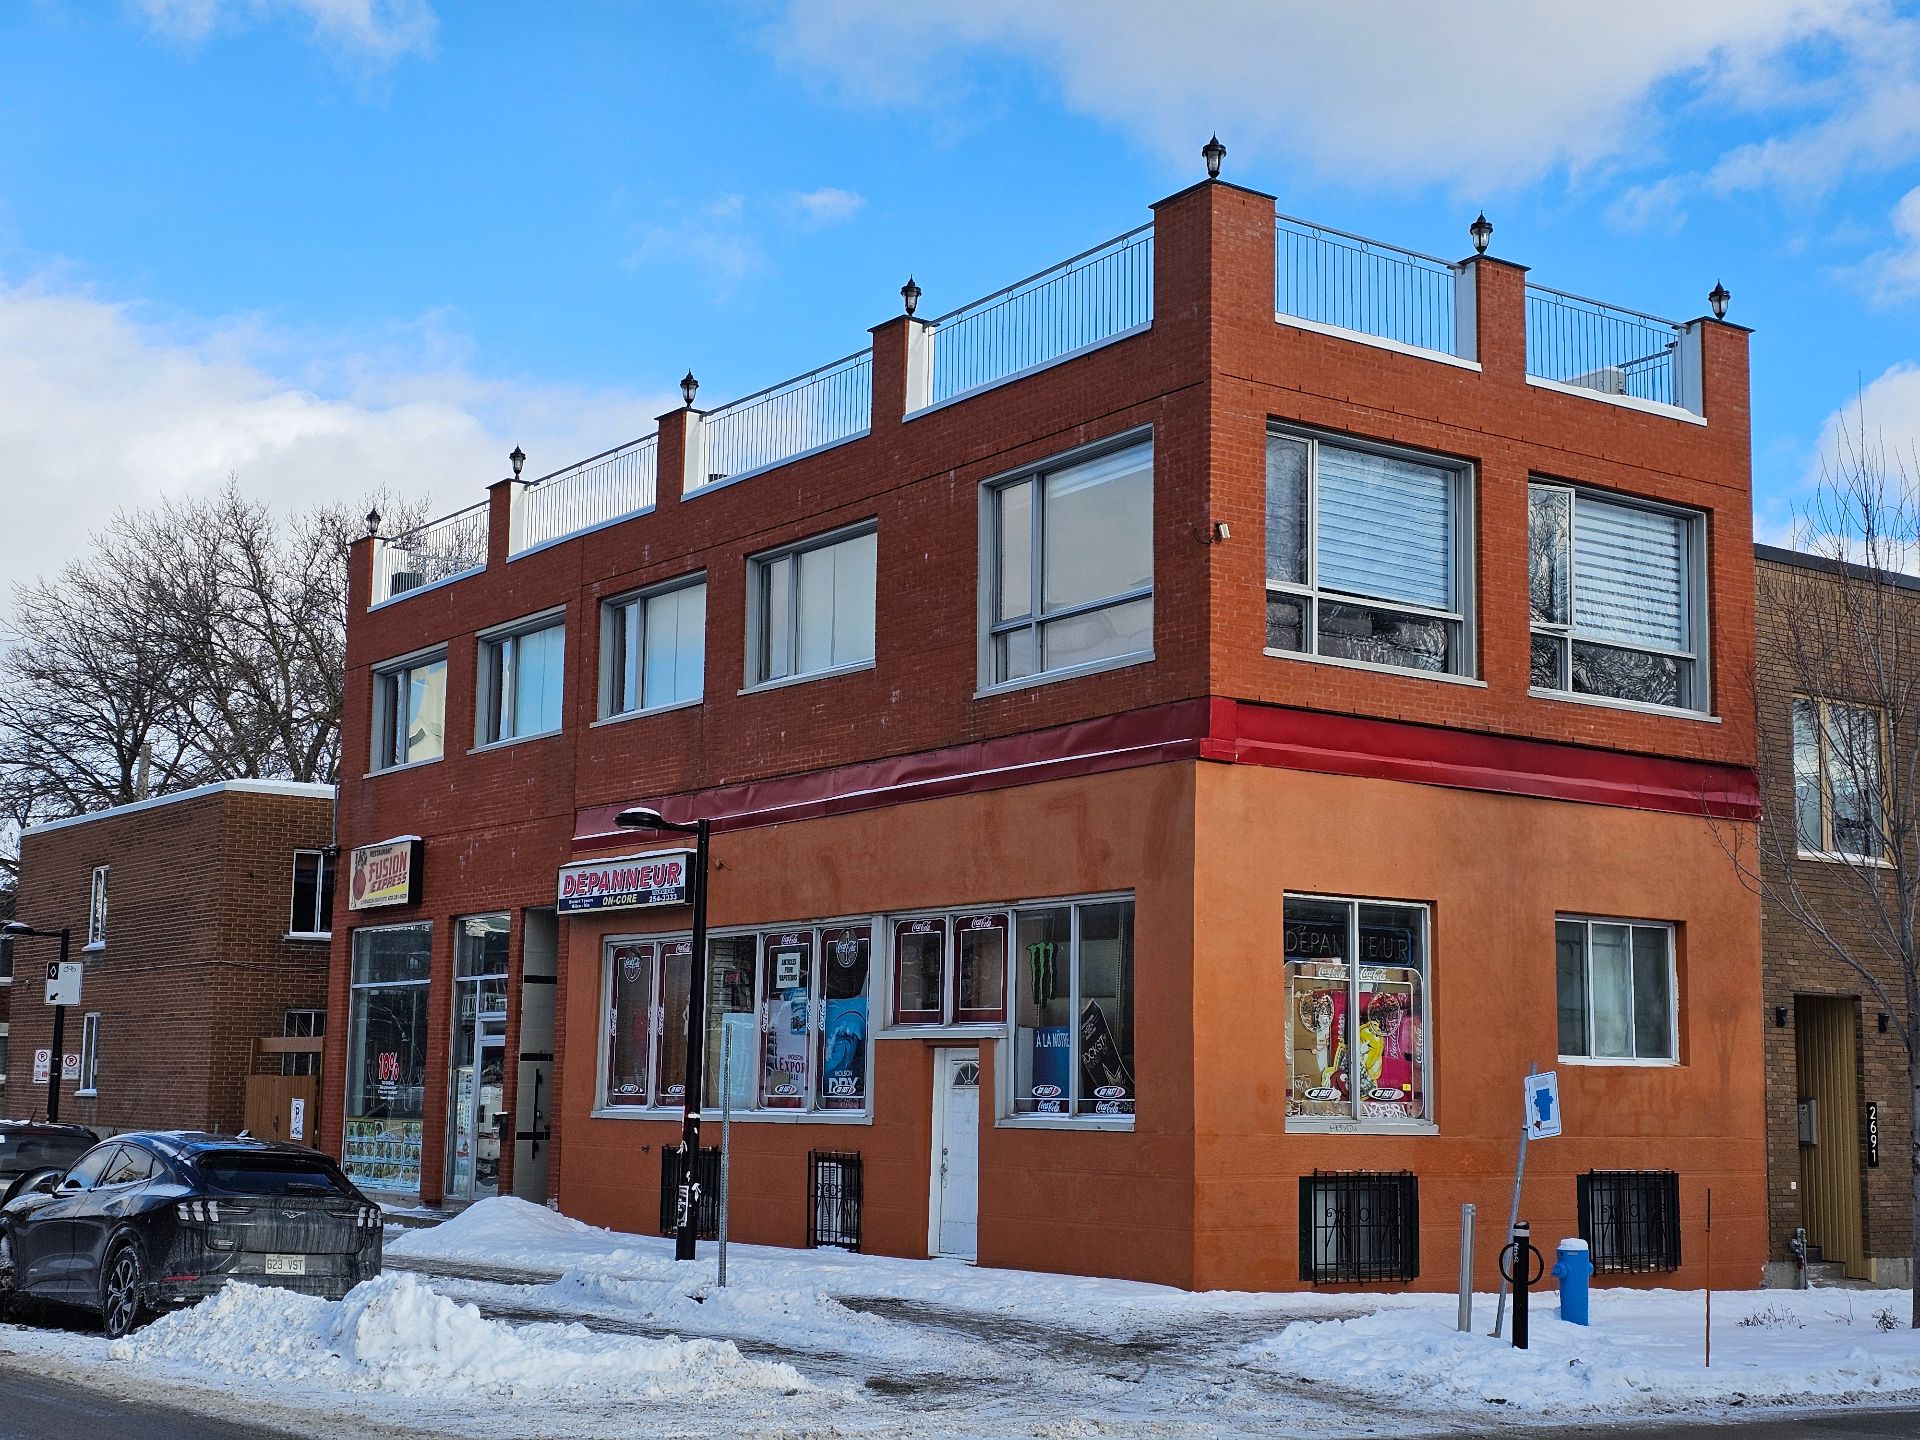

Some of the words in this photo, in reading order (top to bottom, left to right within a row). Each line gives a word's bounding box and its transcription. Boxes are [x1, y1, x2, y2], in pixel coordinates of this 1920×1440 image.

[369, 851, 407, 882] FUSION
[369, 872, 407, 893] EXPRESS
[562, 862, 681, 897] DÉPANNEUR
[602, 894, 638, 906] ON-CORE
[1036, 1031, 1042, 1048] À
[1043, 1033, 1052, 1048] LA
[1053, 1030, 1070, 1048] NÔTRE
[379, 1052, 399, 1080] 10%
[266, 1259, 283, 1270] G23
[287, 1260, 304, 1271] VST
